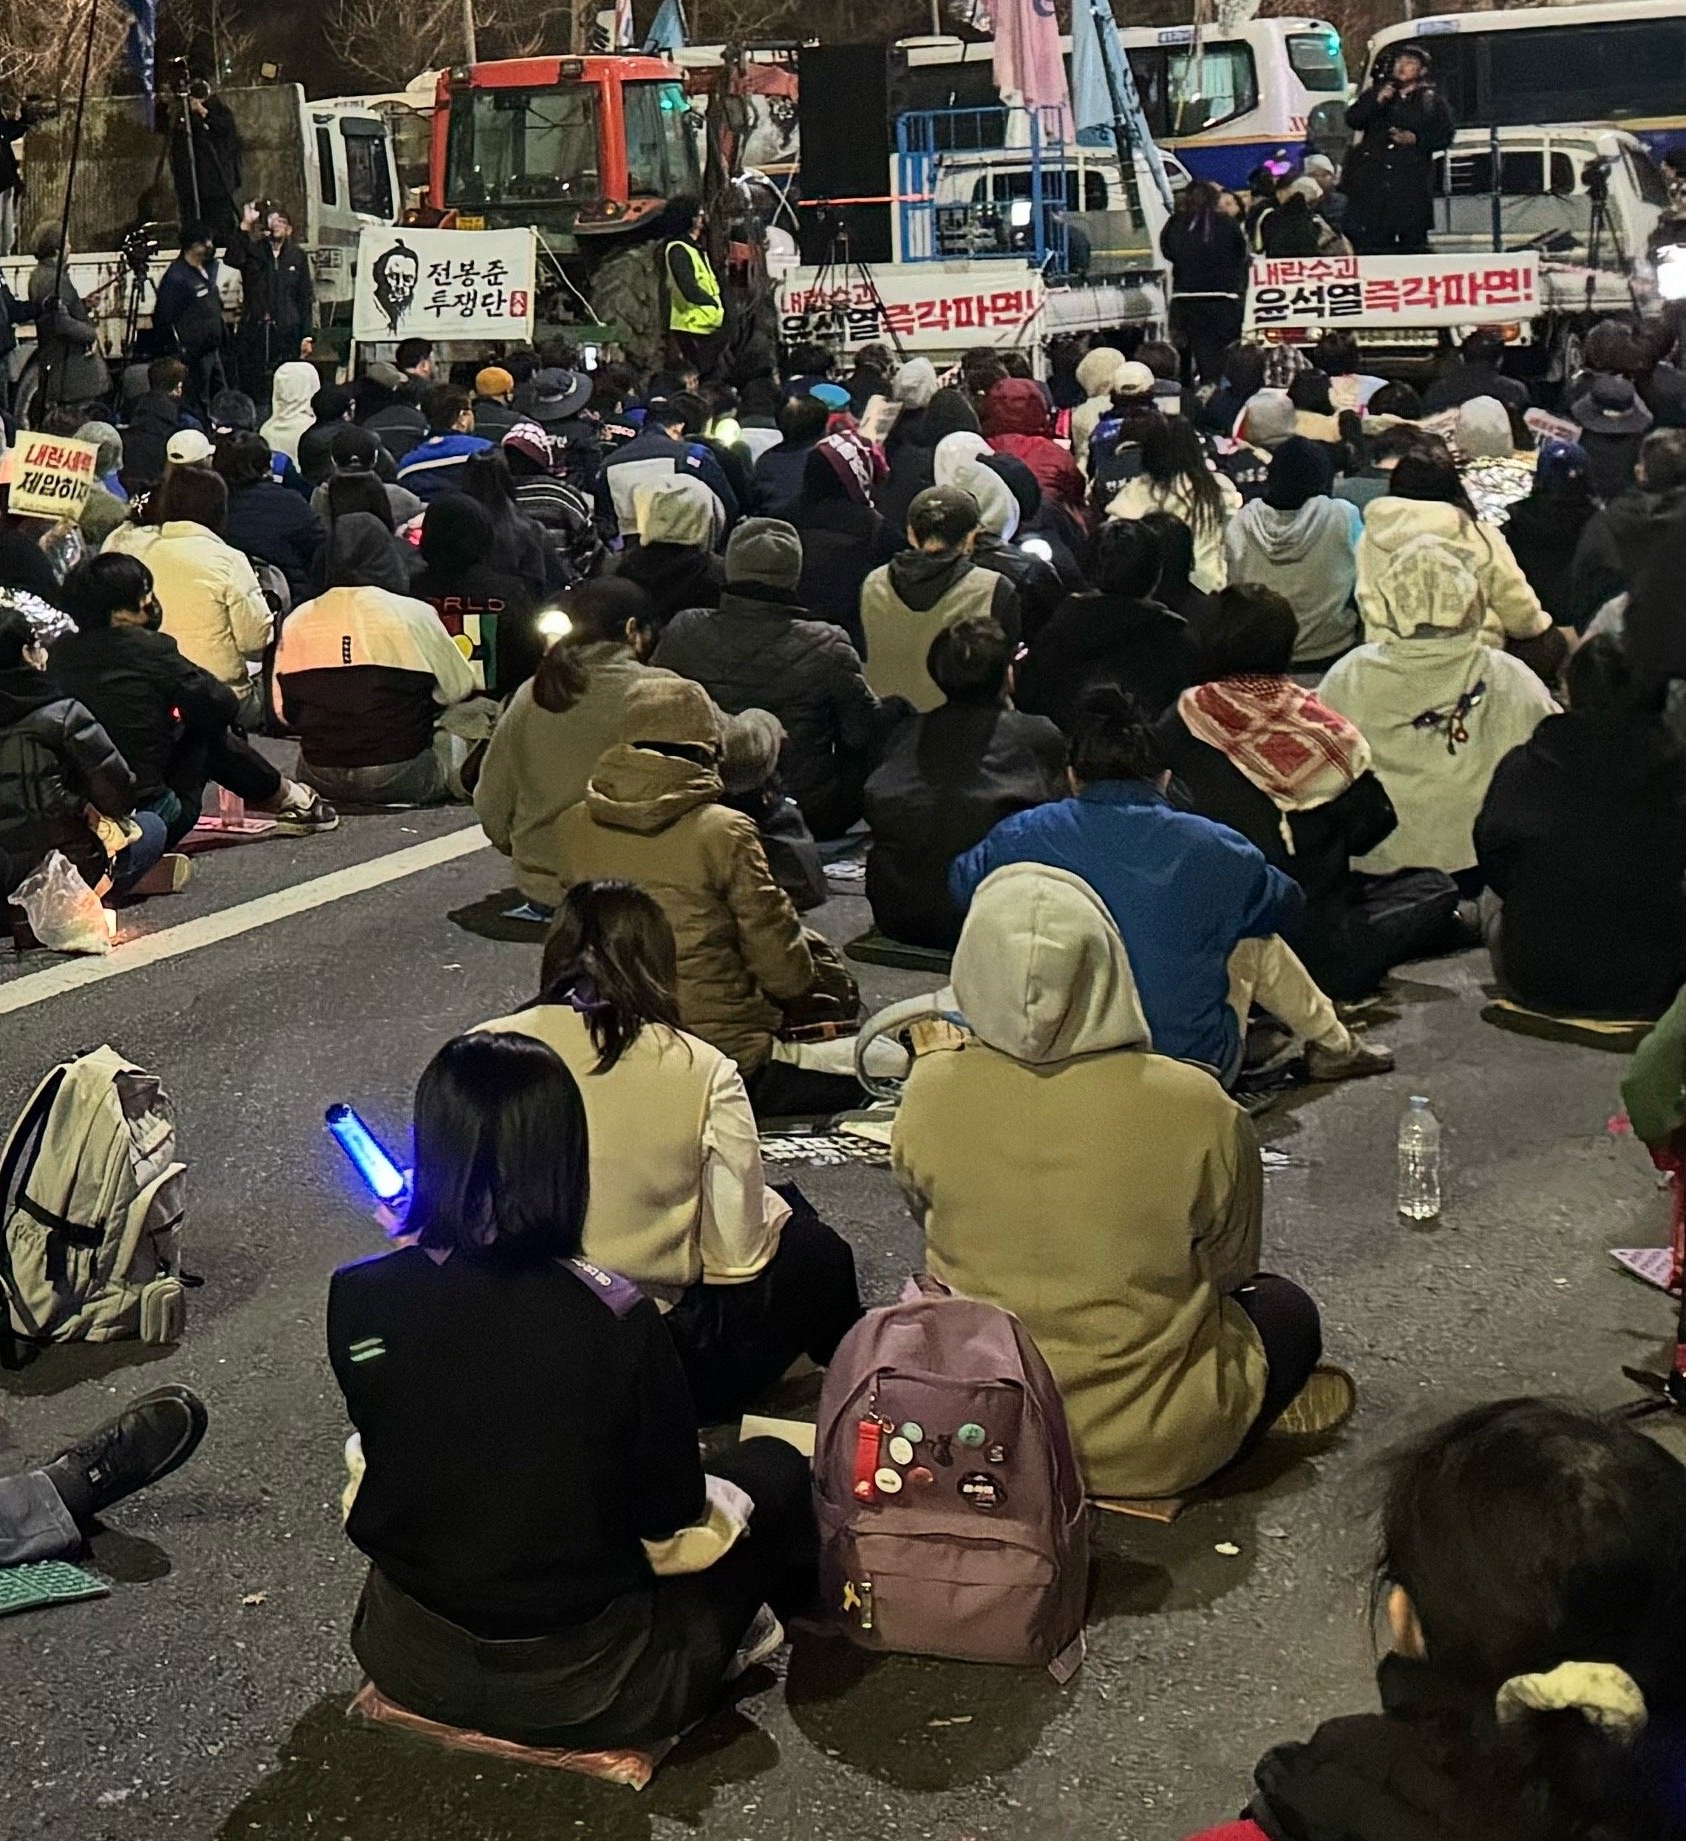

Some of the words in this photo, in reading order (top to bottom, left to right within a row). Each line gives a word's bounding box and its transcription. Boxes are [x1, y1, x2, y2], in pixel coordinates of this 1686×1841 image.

[427, 259, 508, 288] 전봉준
[1252, 256, 1359, 287] 내란수괴
[424, 288, 507, 318] 투쟁단
[1253, 282, 1363, 324] 윤석열
[1364, 267, 1533, 313] 즉각파면!
[881, 288, 1035, 335] 즉각파면!
